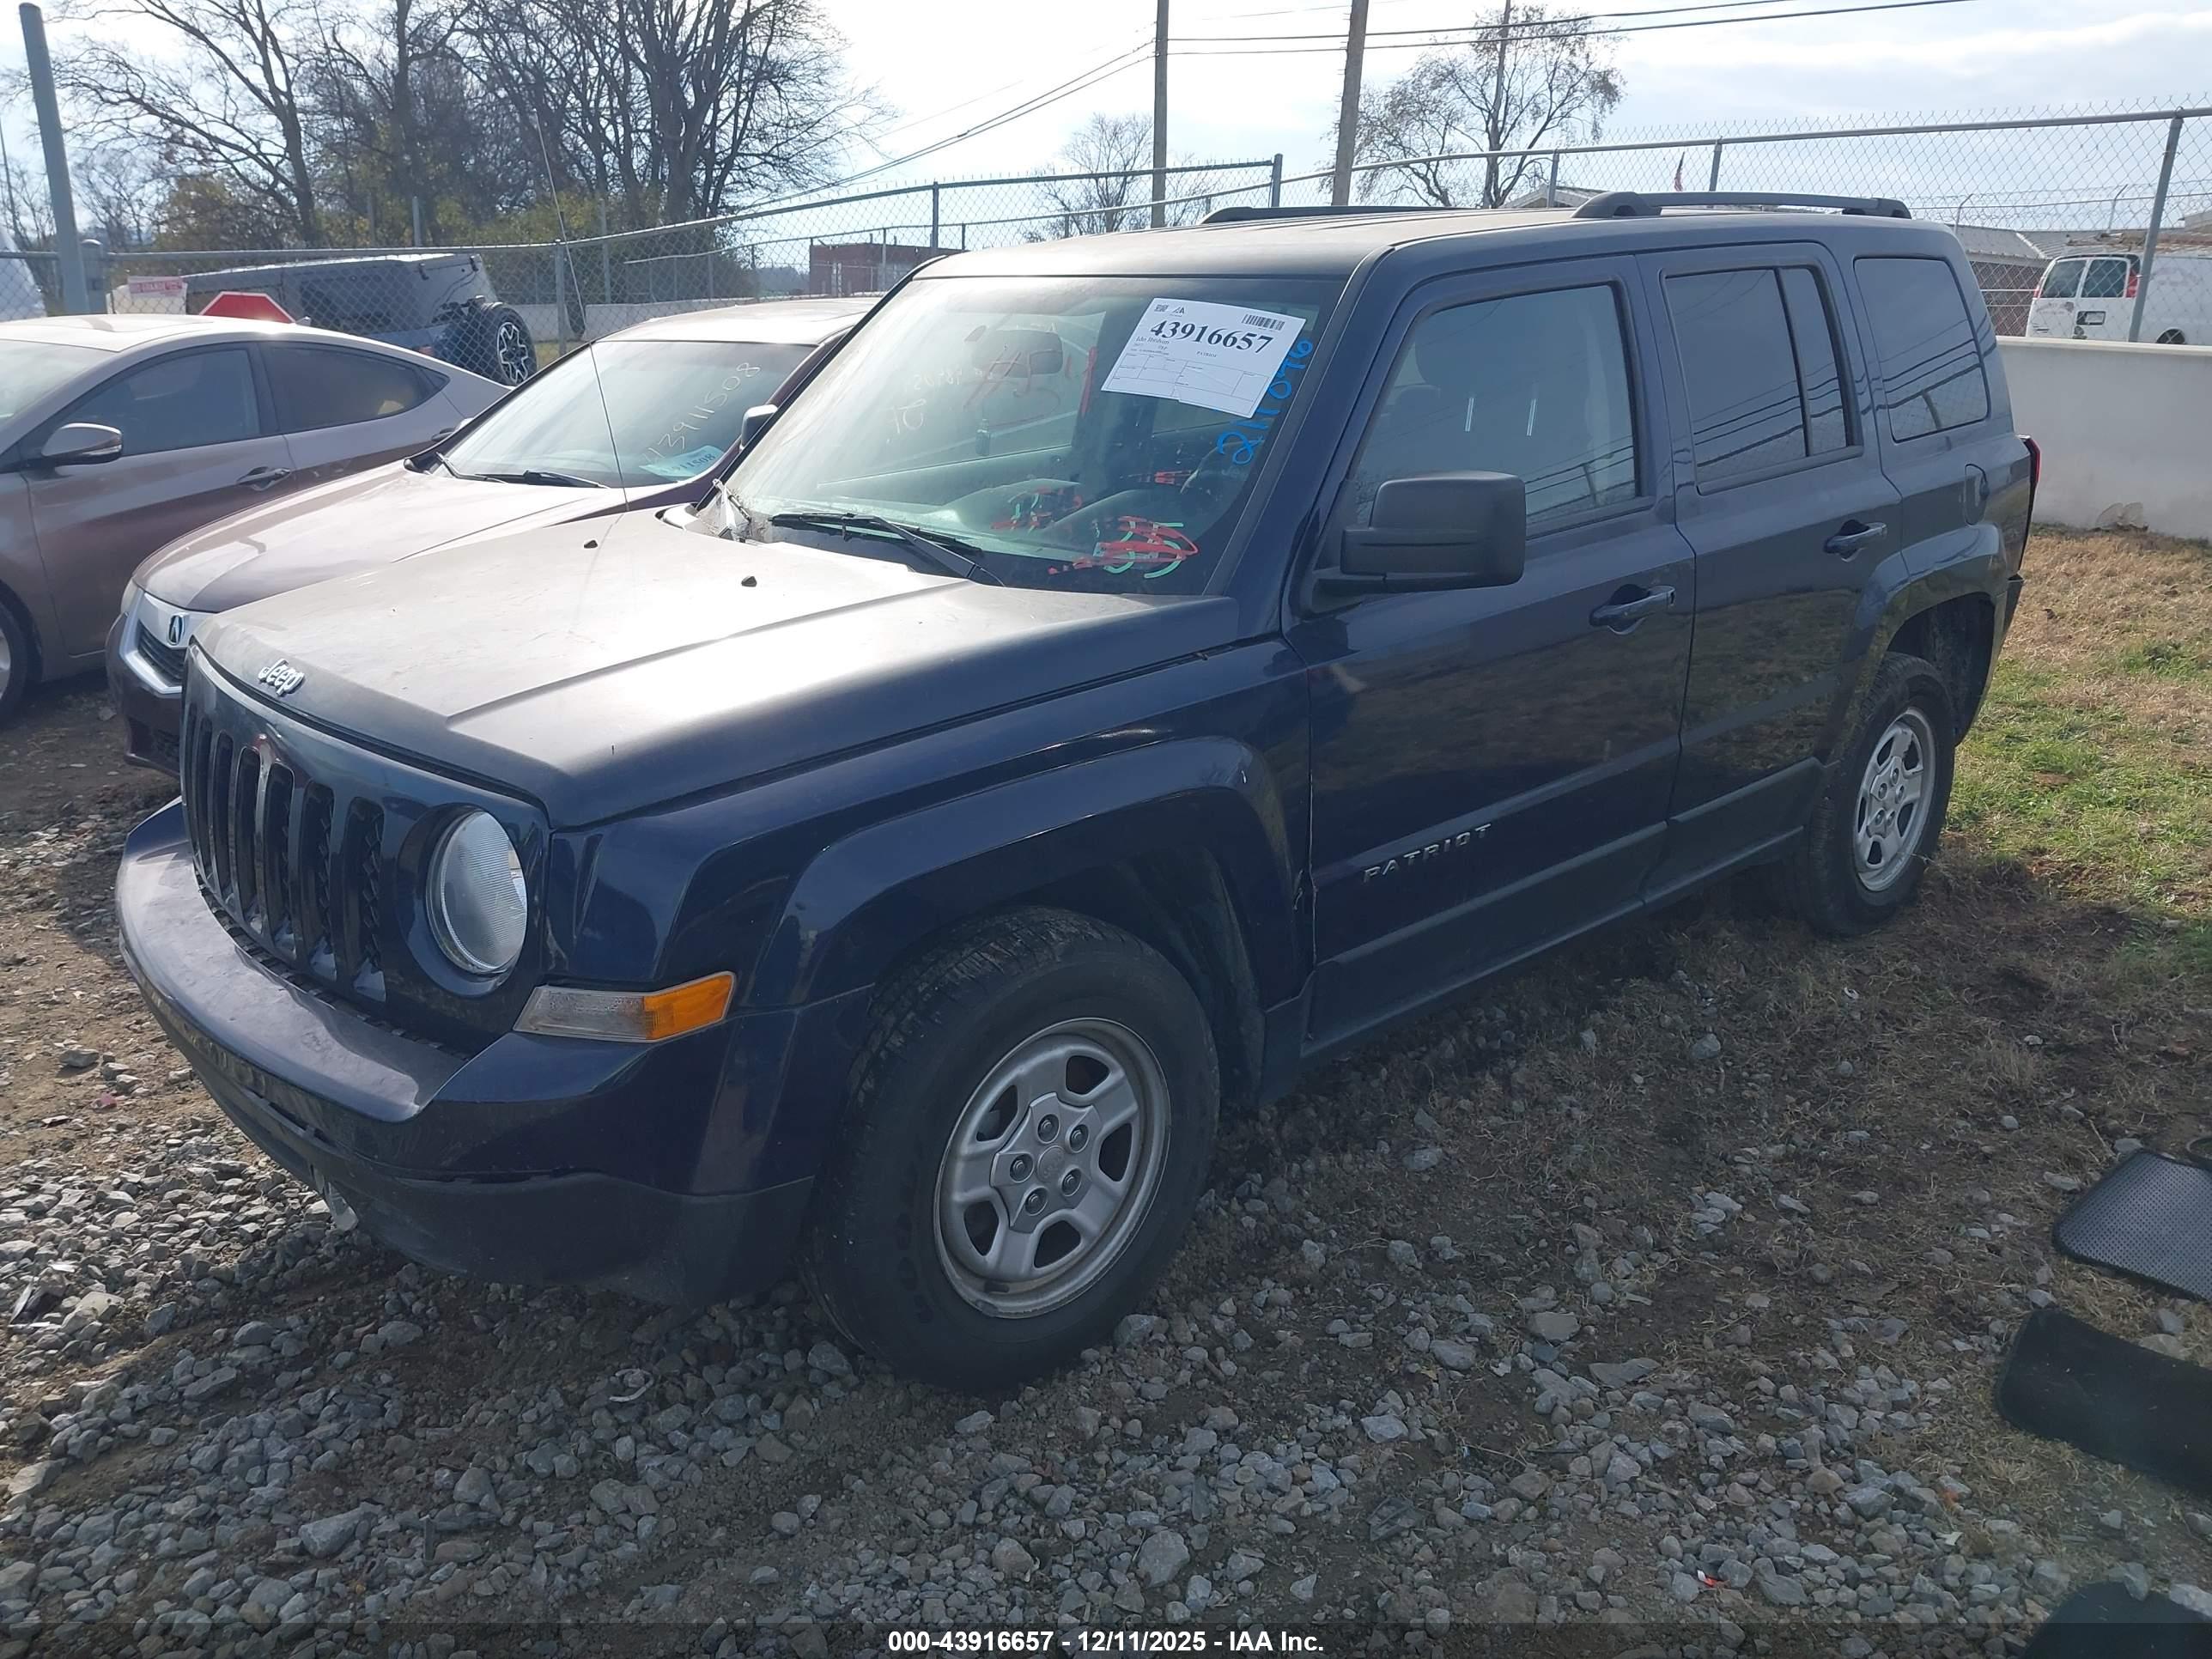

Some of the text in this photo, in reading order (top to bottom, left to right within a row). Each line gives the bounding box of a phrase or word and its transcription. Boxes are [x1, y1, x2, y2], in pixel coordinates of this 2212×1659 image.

[1151, 319, 1274, 354] 43916657
[258, 658, 305, 696] Jeep
[1363, 823, 1492, 884] PATRIOT
